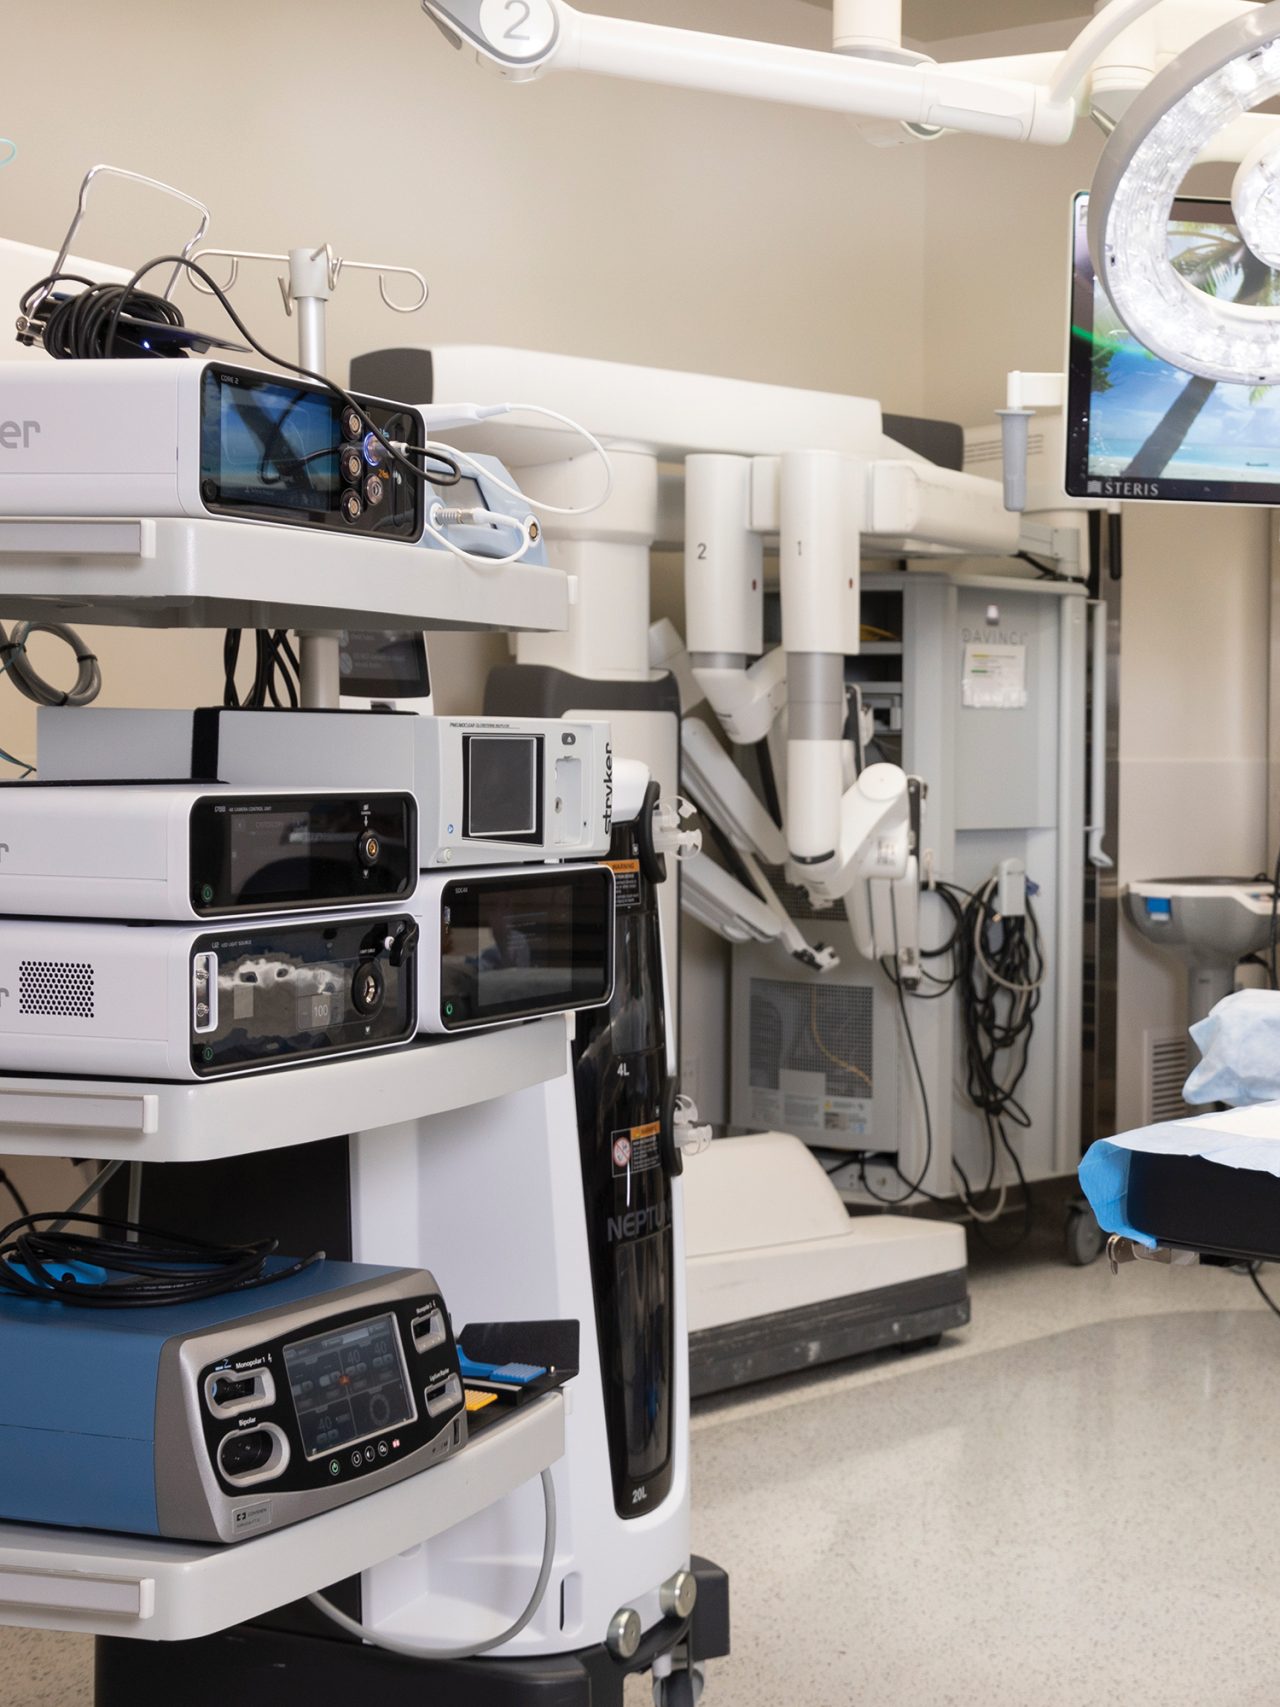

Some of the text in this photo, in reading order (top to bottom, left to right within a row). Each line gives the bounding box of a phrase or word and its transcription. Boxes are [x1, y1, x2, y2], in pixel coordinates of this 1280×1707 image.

[502, 0, 530, 41] 2
[1104, 481, 1160, 497] STERIS
[697, 543, 707, 560] 2
[797, 541, 802, 556] 1
[603, 742, 613, 836] stryker
[313, 1005, 329, 1017] 100
[616, 1062, 630, 1077] 4L
[235, 1358, 262, 1370] Monopolar
[238, 1417, 257, 1427] Bipolar
[631, 1486, 647, 1504] 20L
